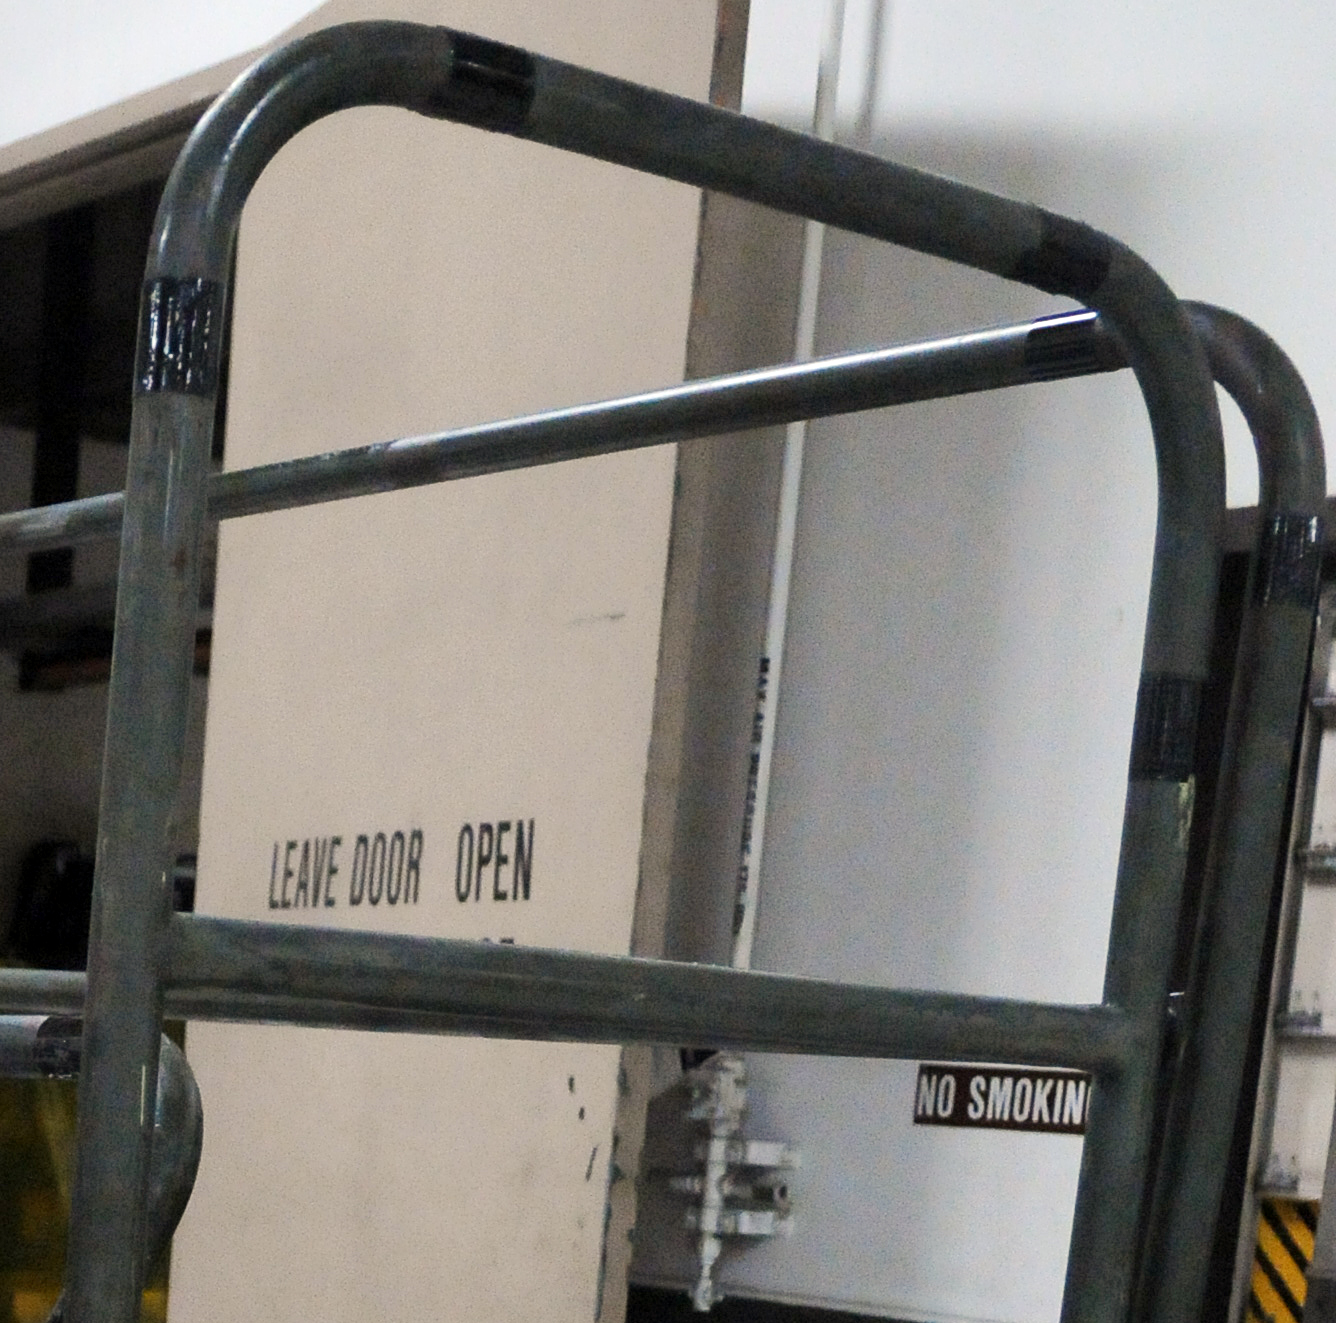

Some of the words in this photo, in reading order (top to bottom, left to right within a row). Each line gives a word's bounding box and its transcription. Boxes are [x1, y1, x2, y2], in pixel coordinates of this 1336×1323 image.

[269, 837, 342, 909] LEAVE
[349, 829, 424, 906] DOOR
[455, 817, 535, 903] OPEN
[918, 1073, 956, 1118] NO
[967, 1074, 1091, 1126] SMOKIN
